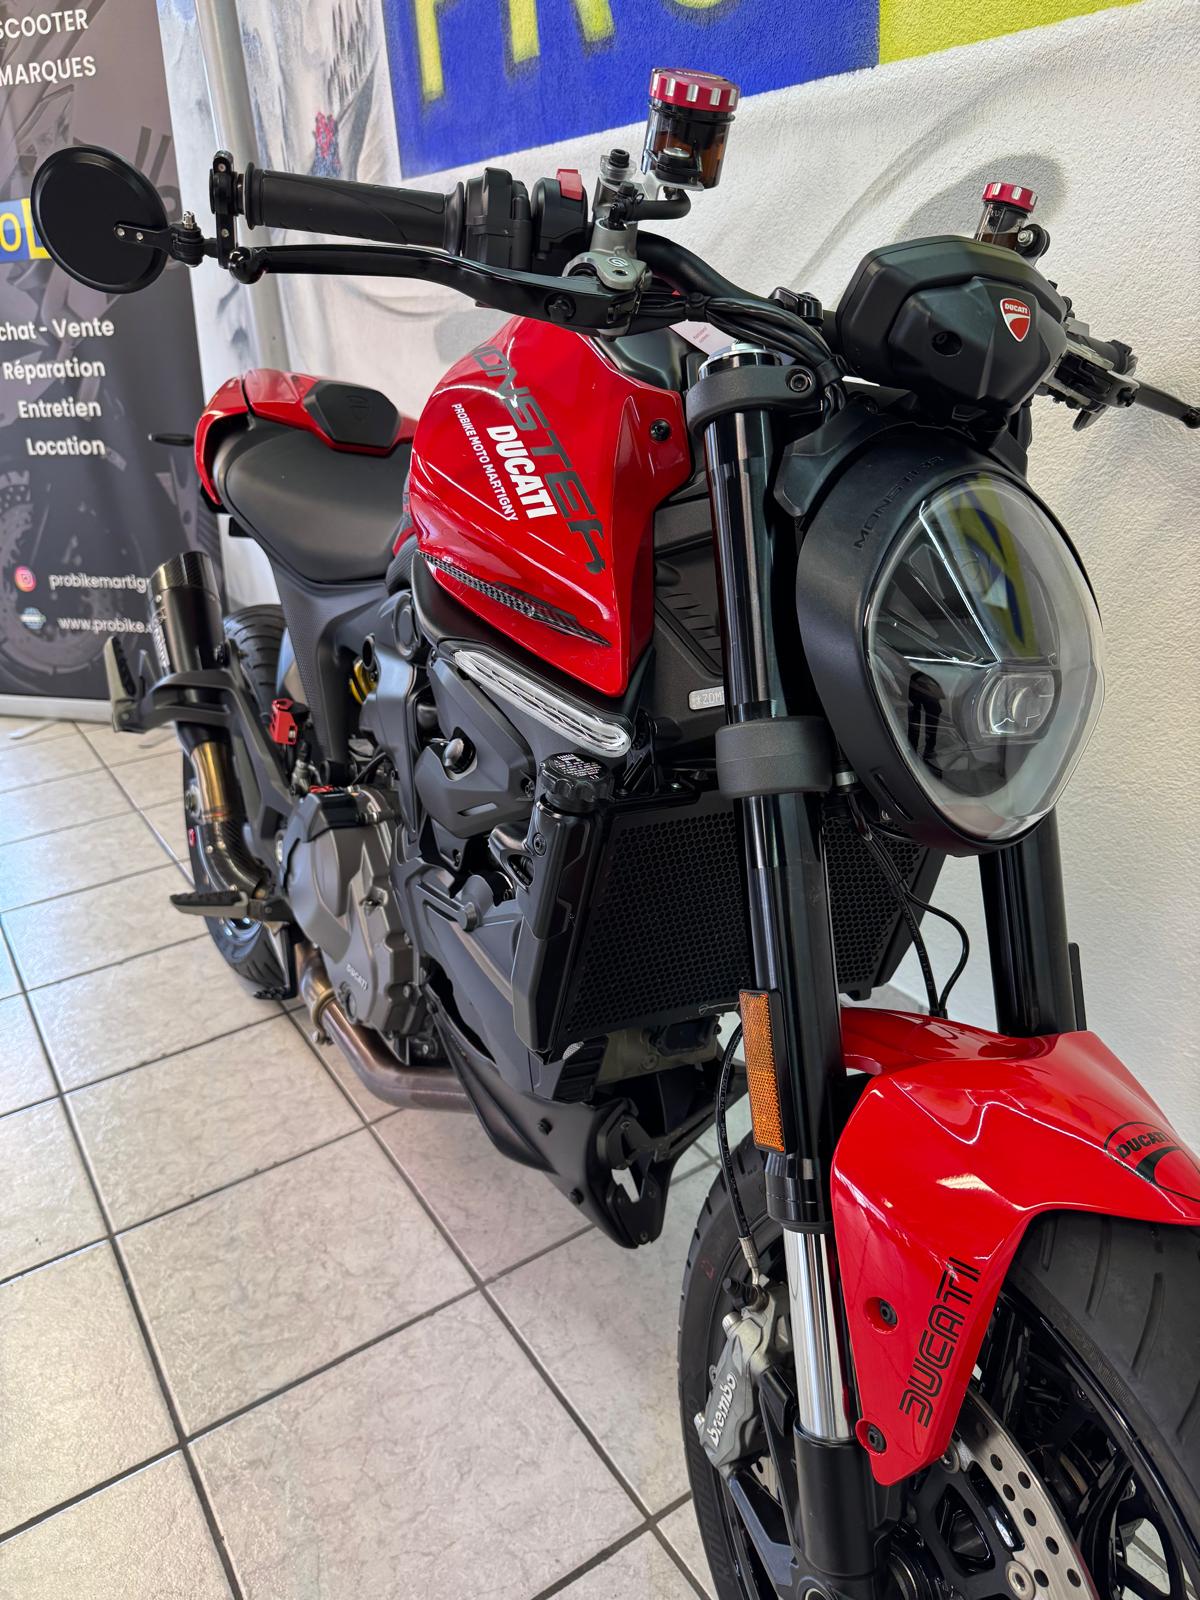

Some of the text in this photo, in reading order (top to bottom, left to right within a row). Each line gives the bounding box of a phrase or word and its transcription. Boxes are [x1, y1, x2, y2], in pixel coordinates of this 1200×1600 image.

[1004, 302, 1028, 314] DUCATI
[52, 318, 114, 338] Vente
[3, 358, 105, 385] Réparation
[18, 398, 101, 419] Entretien
[27, 437, 106, 456] Location
[451, 403, 519, 521] PROBIKE MOTO MARTIGNY
[486, 425, 557, 519] DUCATI
[899, 1256, 981, 1428] DUCATI
[707, 1371, 737, 1447] brembo
